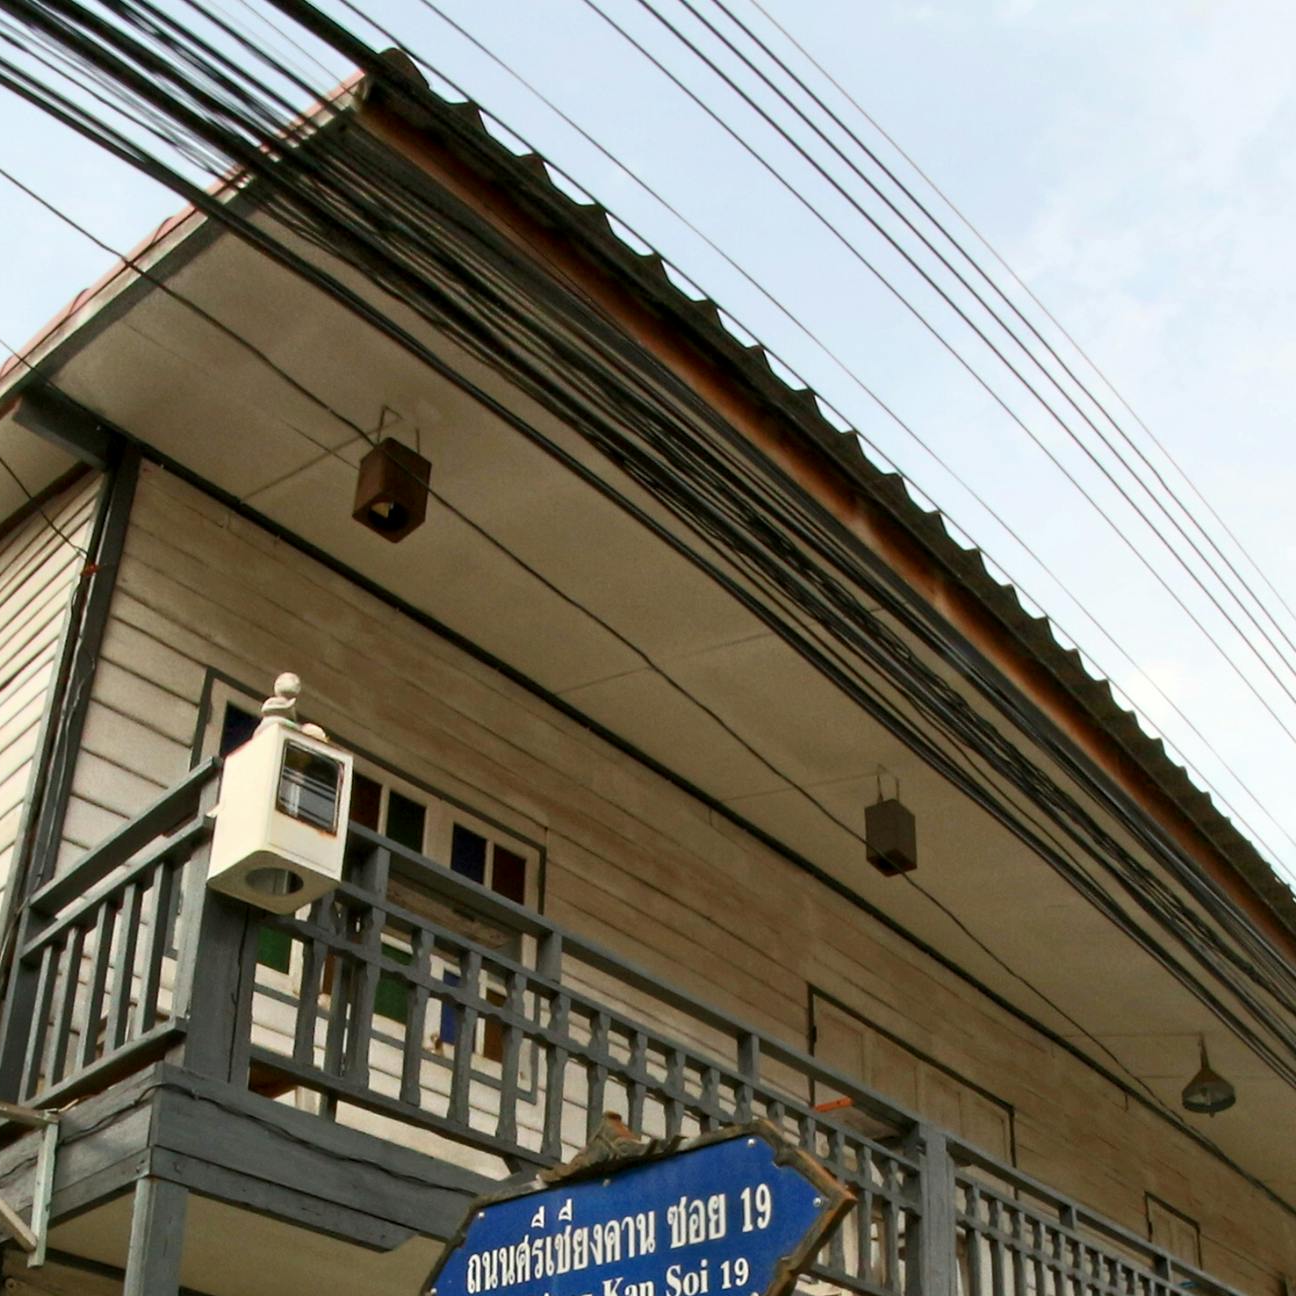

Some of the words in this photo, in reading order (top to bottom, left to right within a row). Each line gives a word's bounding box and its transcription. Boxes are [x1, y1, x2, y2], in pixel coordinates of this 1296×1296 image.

[466, 1199, 655, 1294] ถนนศรีเชียงคาน
[667, 1193, 727, 1249] ซอย
[740, 1183, 772, 1233] 19
[720, 1257, 750, 1290] 19
